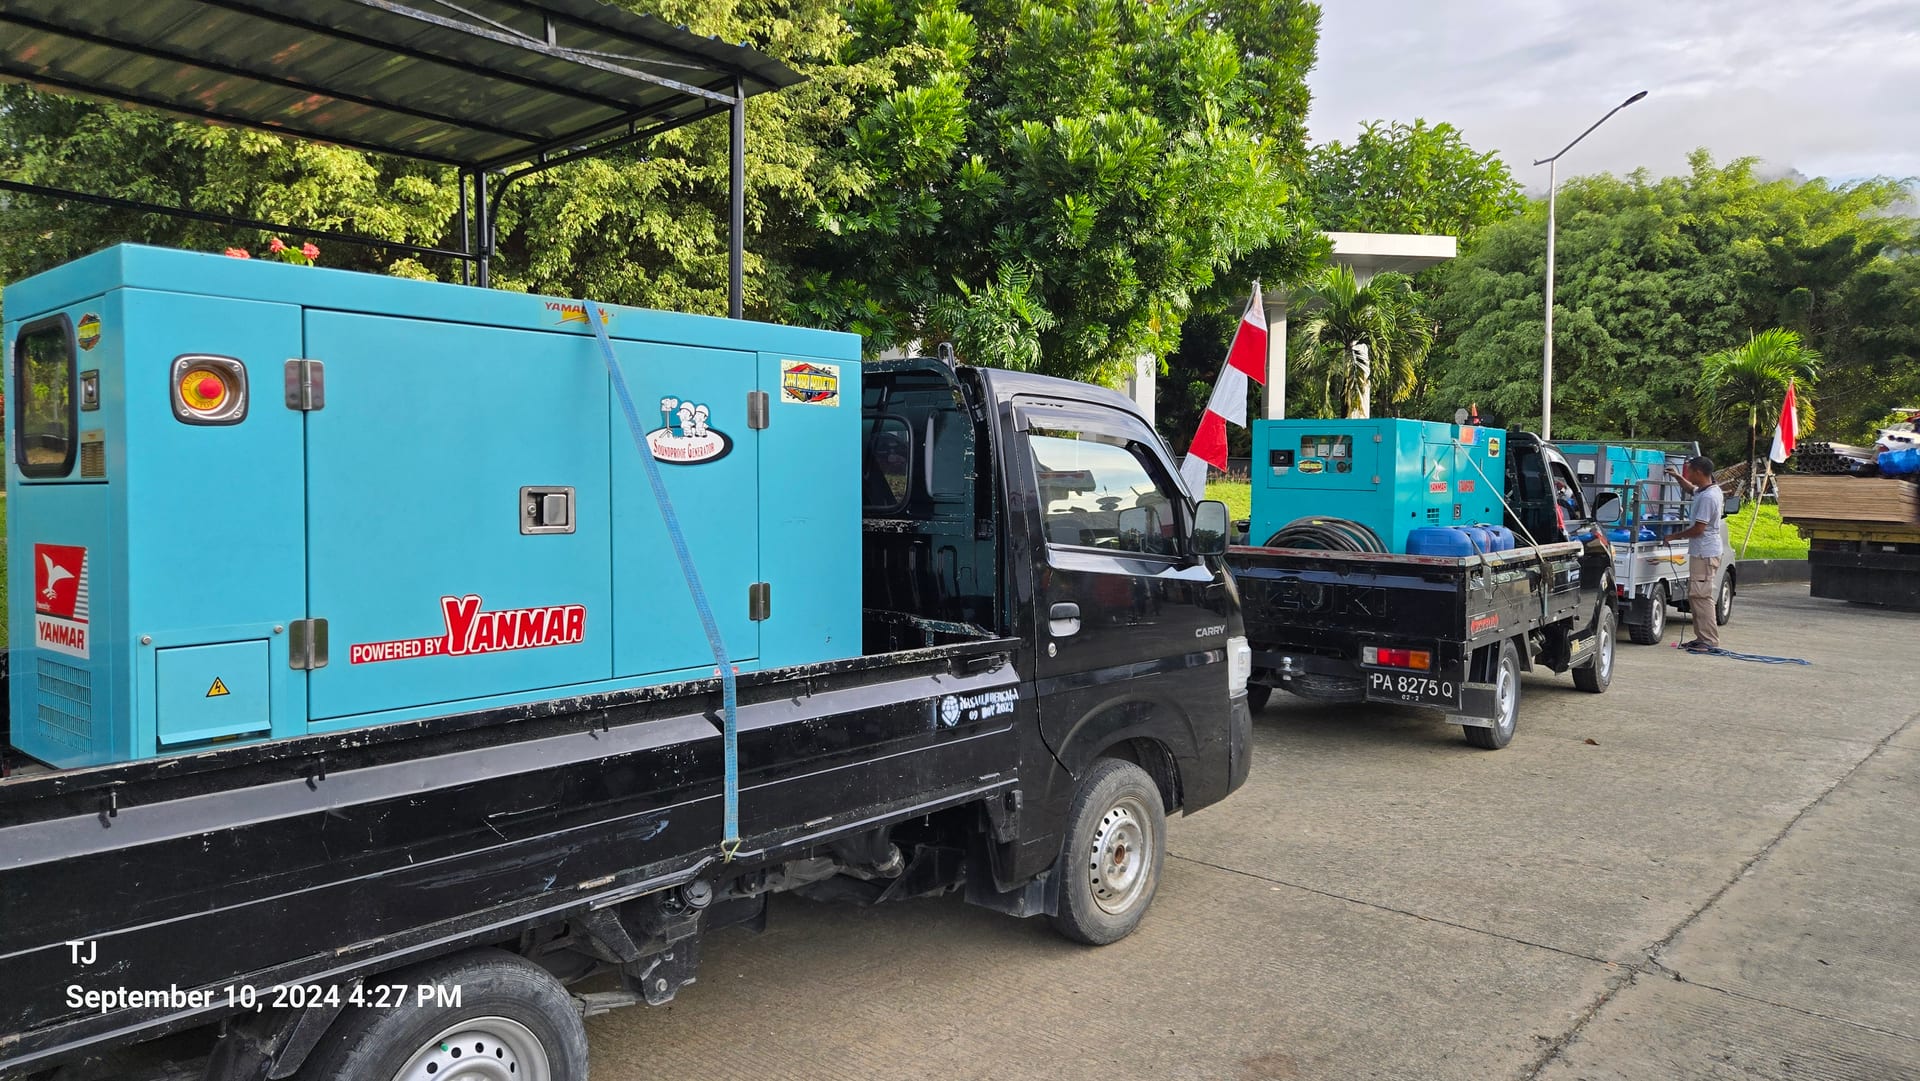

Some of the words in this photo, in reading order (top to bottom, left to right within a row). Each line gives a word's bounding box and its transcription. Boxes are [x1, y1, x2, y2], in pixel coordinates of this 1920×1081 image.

[39, 621, 84, 650] YANMAR
[353, 640, 421, 663] POWERED
[424, 638, 443, 655] BY
[443, 596, 585, 654] YANMAR
[1195, 624, 1226, 638] CARRY
[1373, 673, 1393, 691] PA
[1398, 676, 1438, 696] 8275
[1442, 681, 1453, 698] Q
